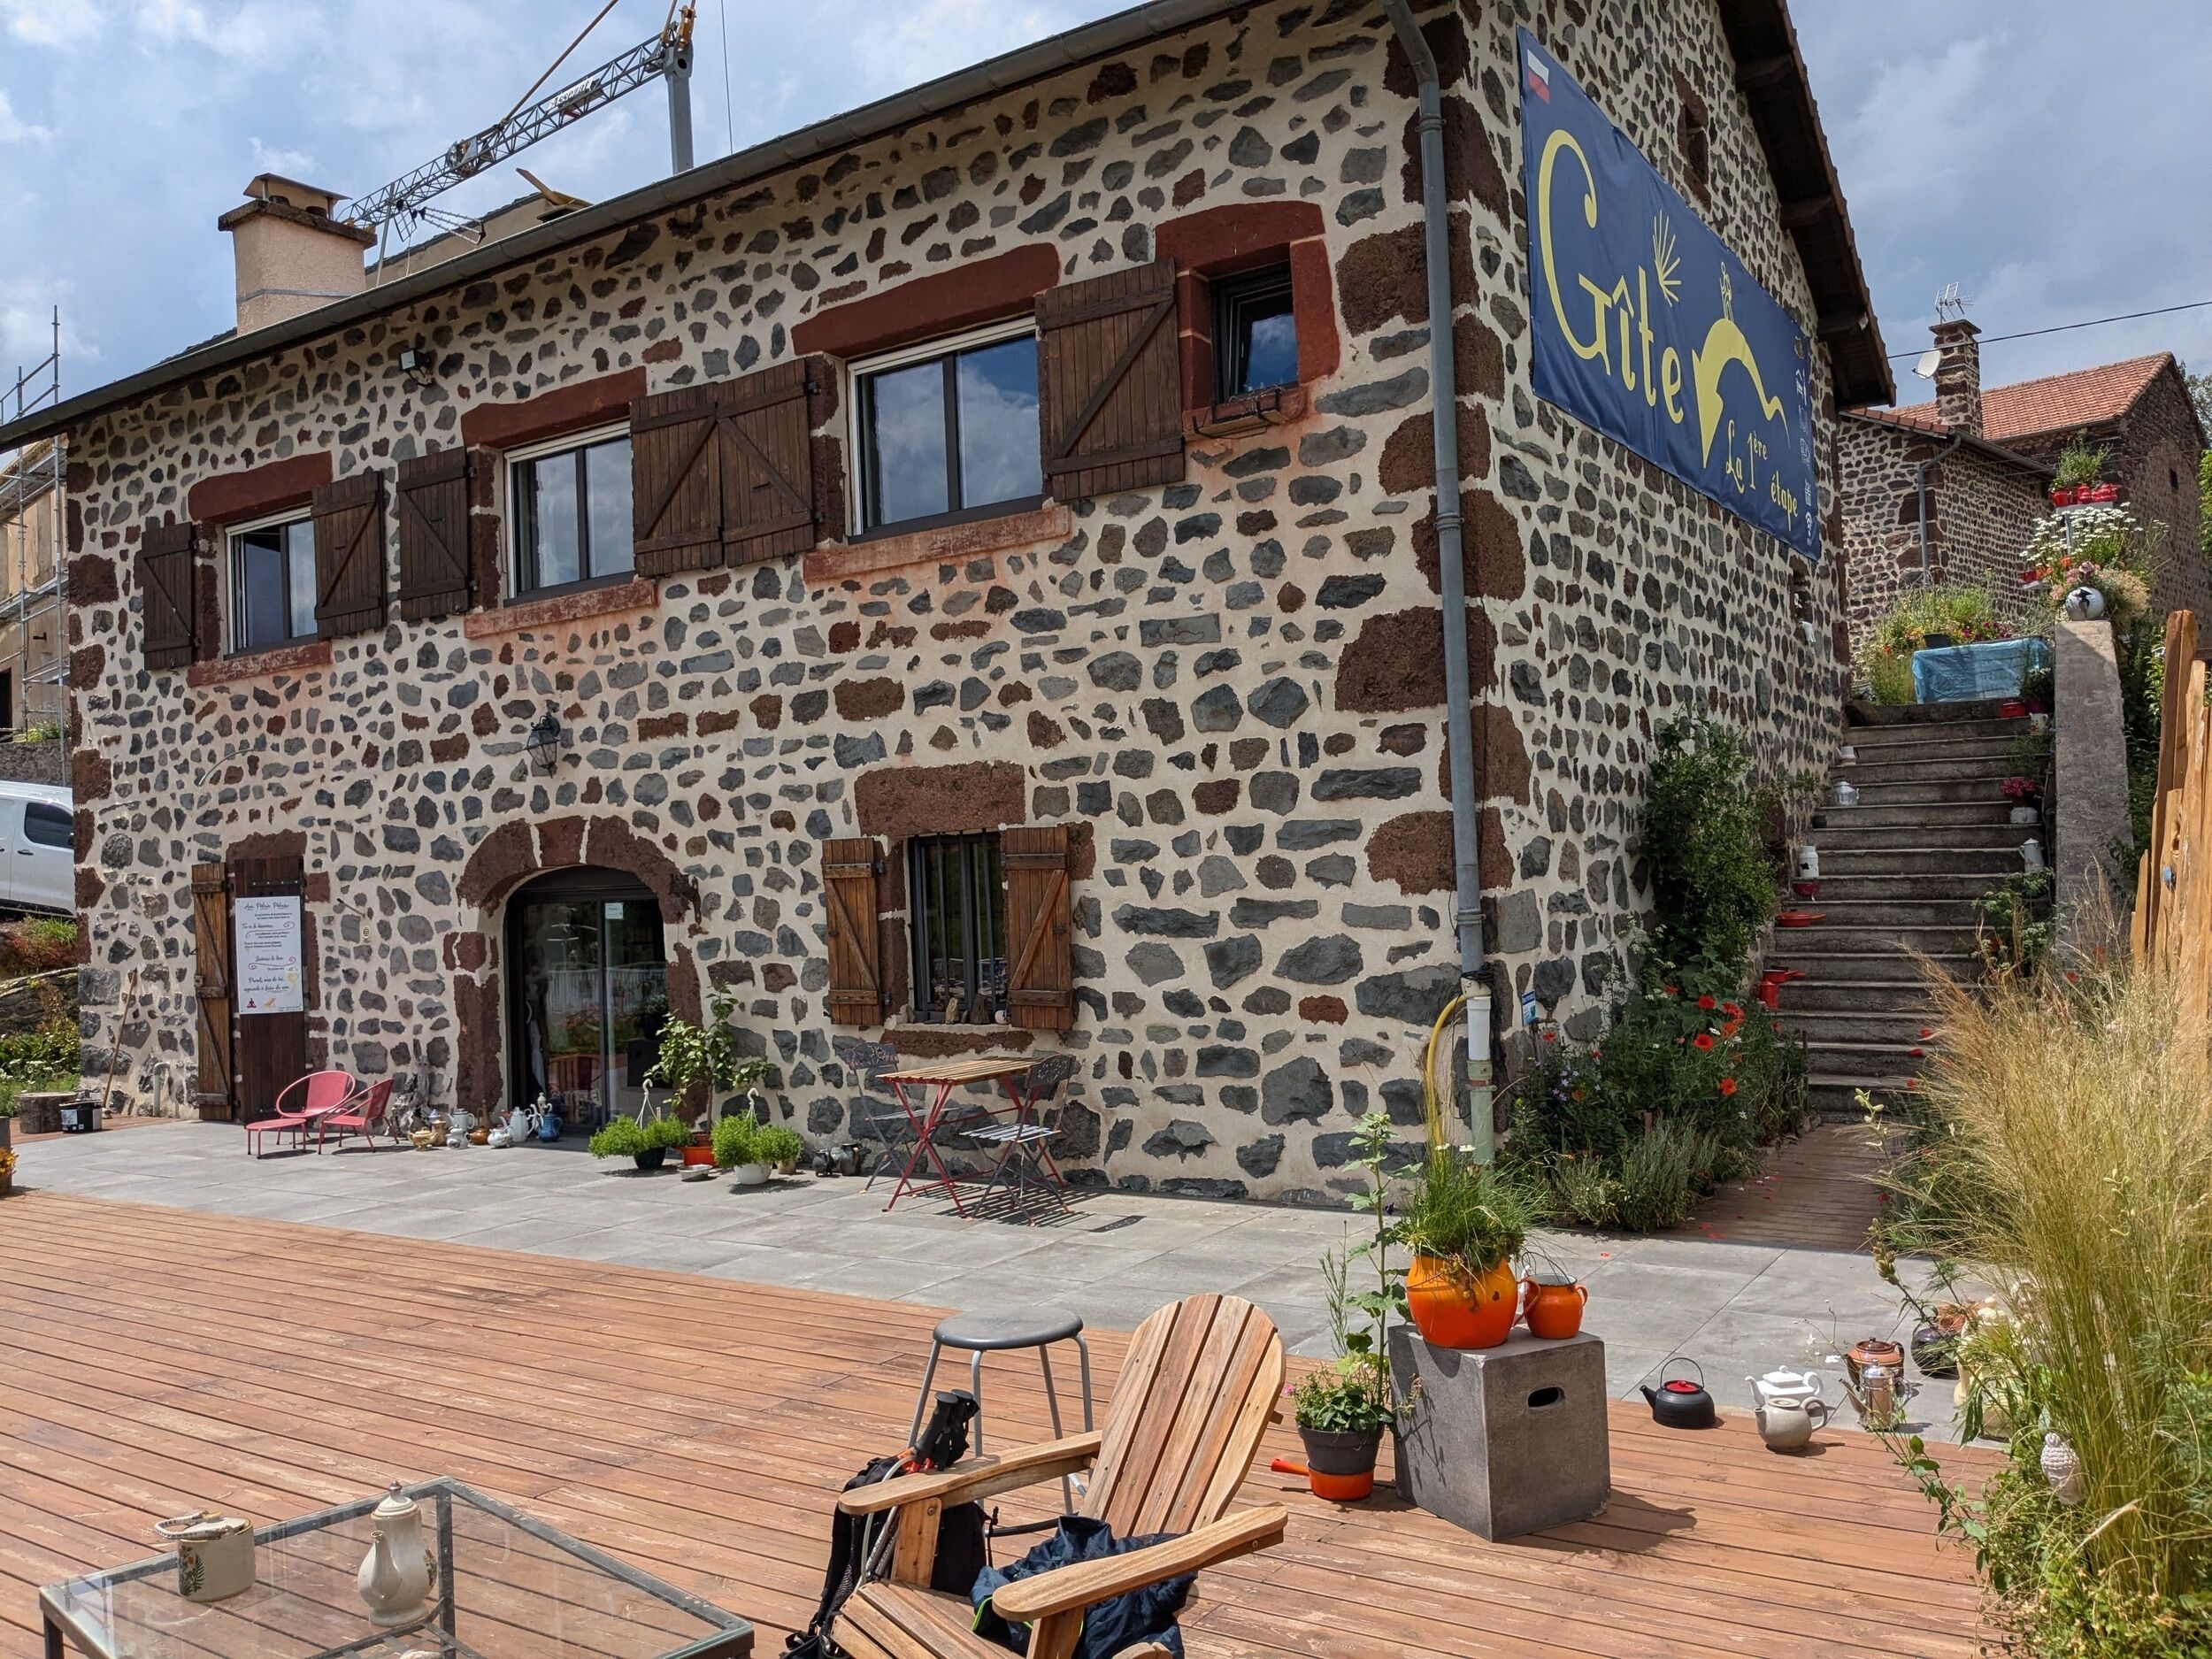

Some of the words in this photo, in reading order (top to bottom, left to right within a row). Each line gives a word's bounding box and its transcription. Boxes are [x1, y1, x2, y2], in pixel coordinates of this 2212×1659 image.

[1538, 129, 1684, 424] Gîte
[1726, 419, 1745, 494] La
[1770, 471, 1798, 531] étape
